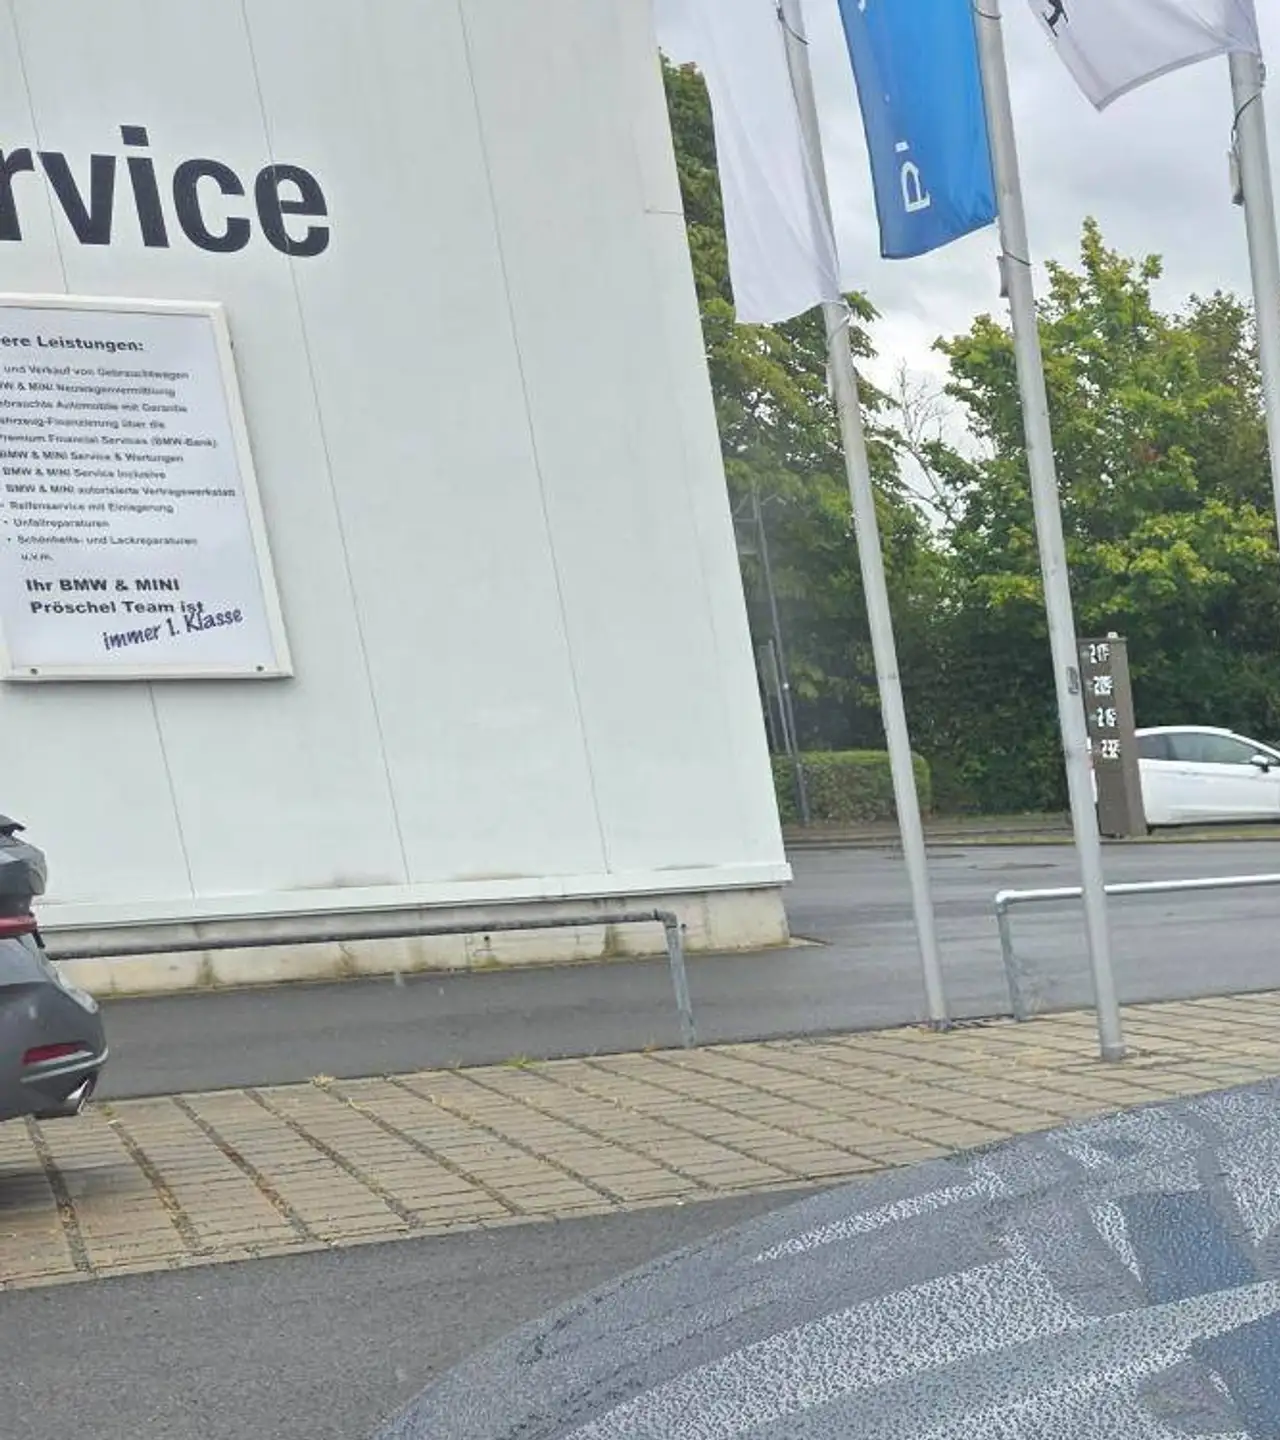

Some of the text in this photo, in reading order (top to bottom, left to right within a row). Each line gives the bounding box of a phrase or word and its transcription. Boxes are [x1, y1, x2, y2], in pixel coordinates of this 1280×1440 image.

[0, 125, 330, 257] rvice
[37, 335, 143, 353] Leistungen:
[26, 578, 180, 591] Ihr BMW & MINI
[30, 600, 204, 614] Pröschel Team ist
[103, 622, 161, 650] immer
[184, 608, 244, 634] Klasse
